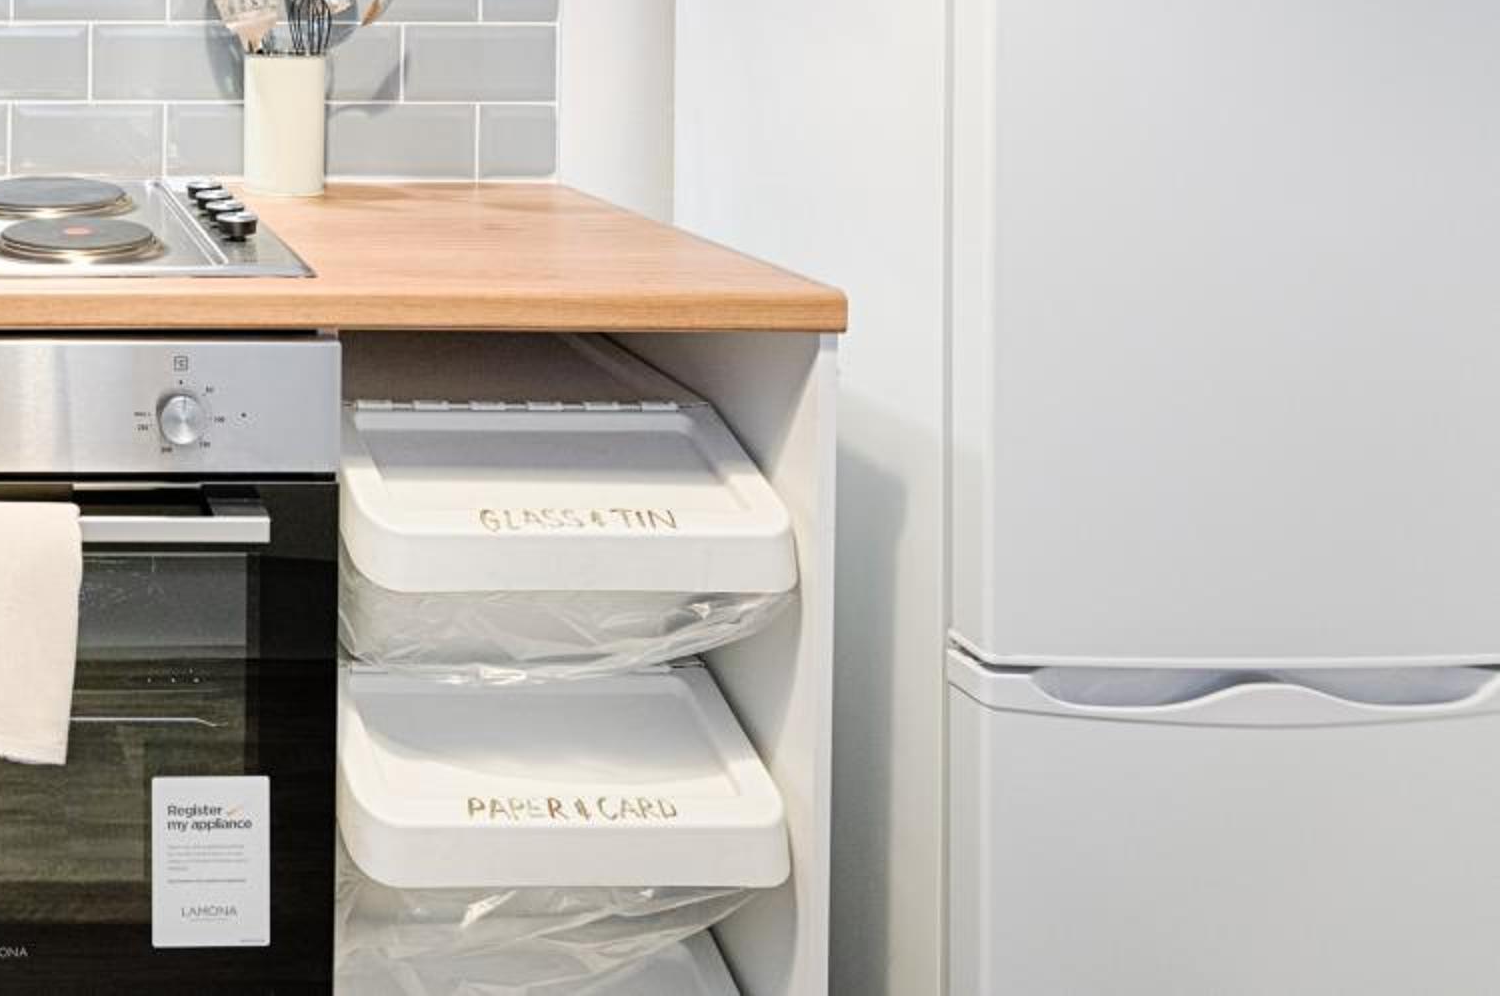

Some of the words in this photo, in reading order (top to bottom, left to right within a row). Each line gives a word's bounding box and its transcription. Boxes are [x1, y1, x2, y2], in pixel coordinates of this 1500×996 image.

[479, 508, 585, 532] GLASS
[609, 507, 678, 530] TIN
[167, 804, 223, 819] Register
[467, 797, 570, 821] PAPER
[596, 796, 678, 821] CARD
[167, 820, 188, 833] my
[191, 818, 252, 832] appliance
